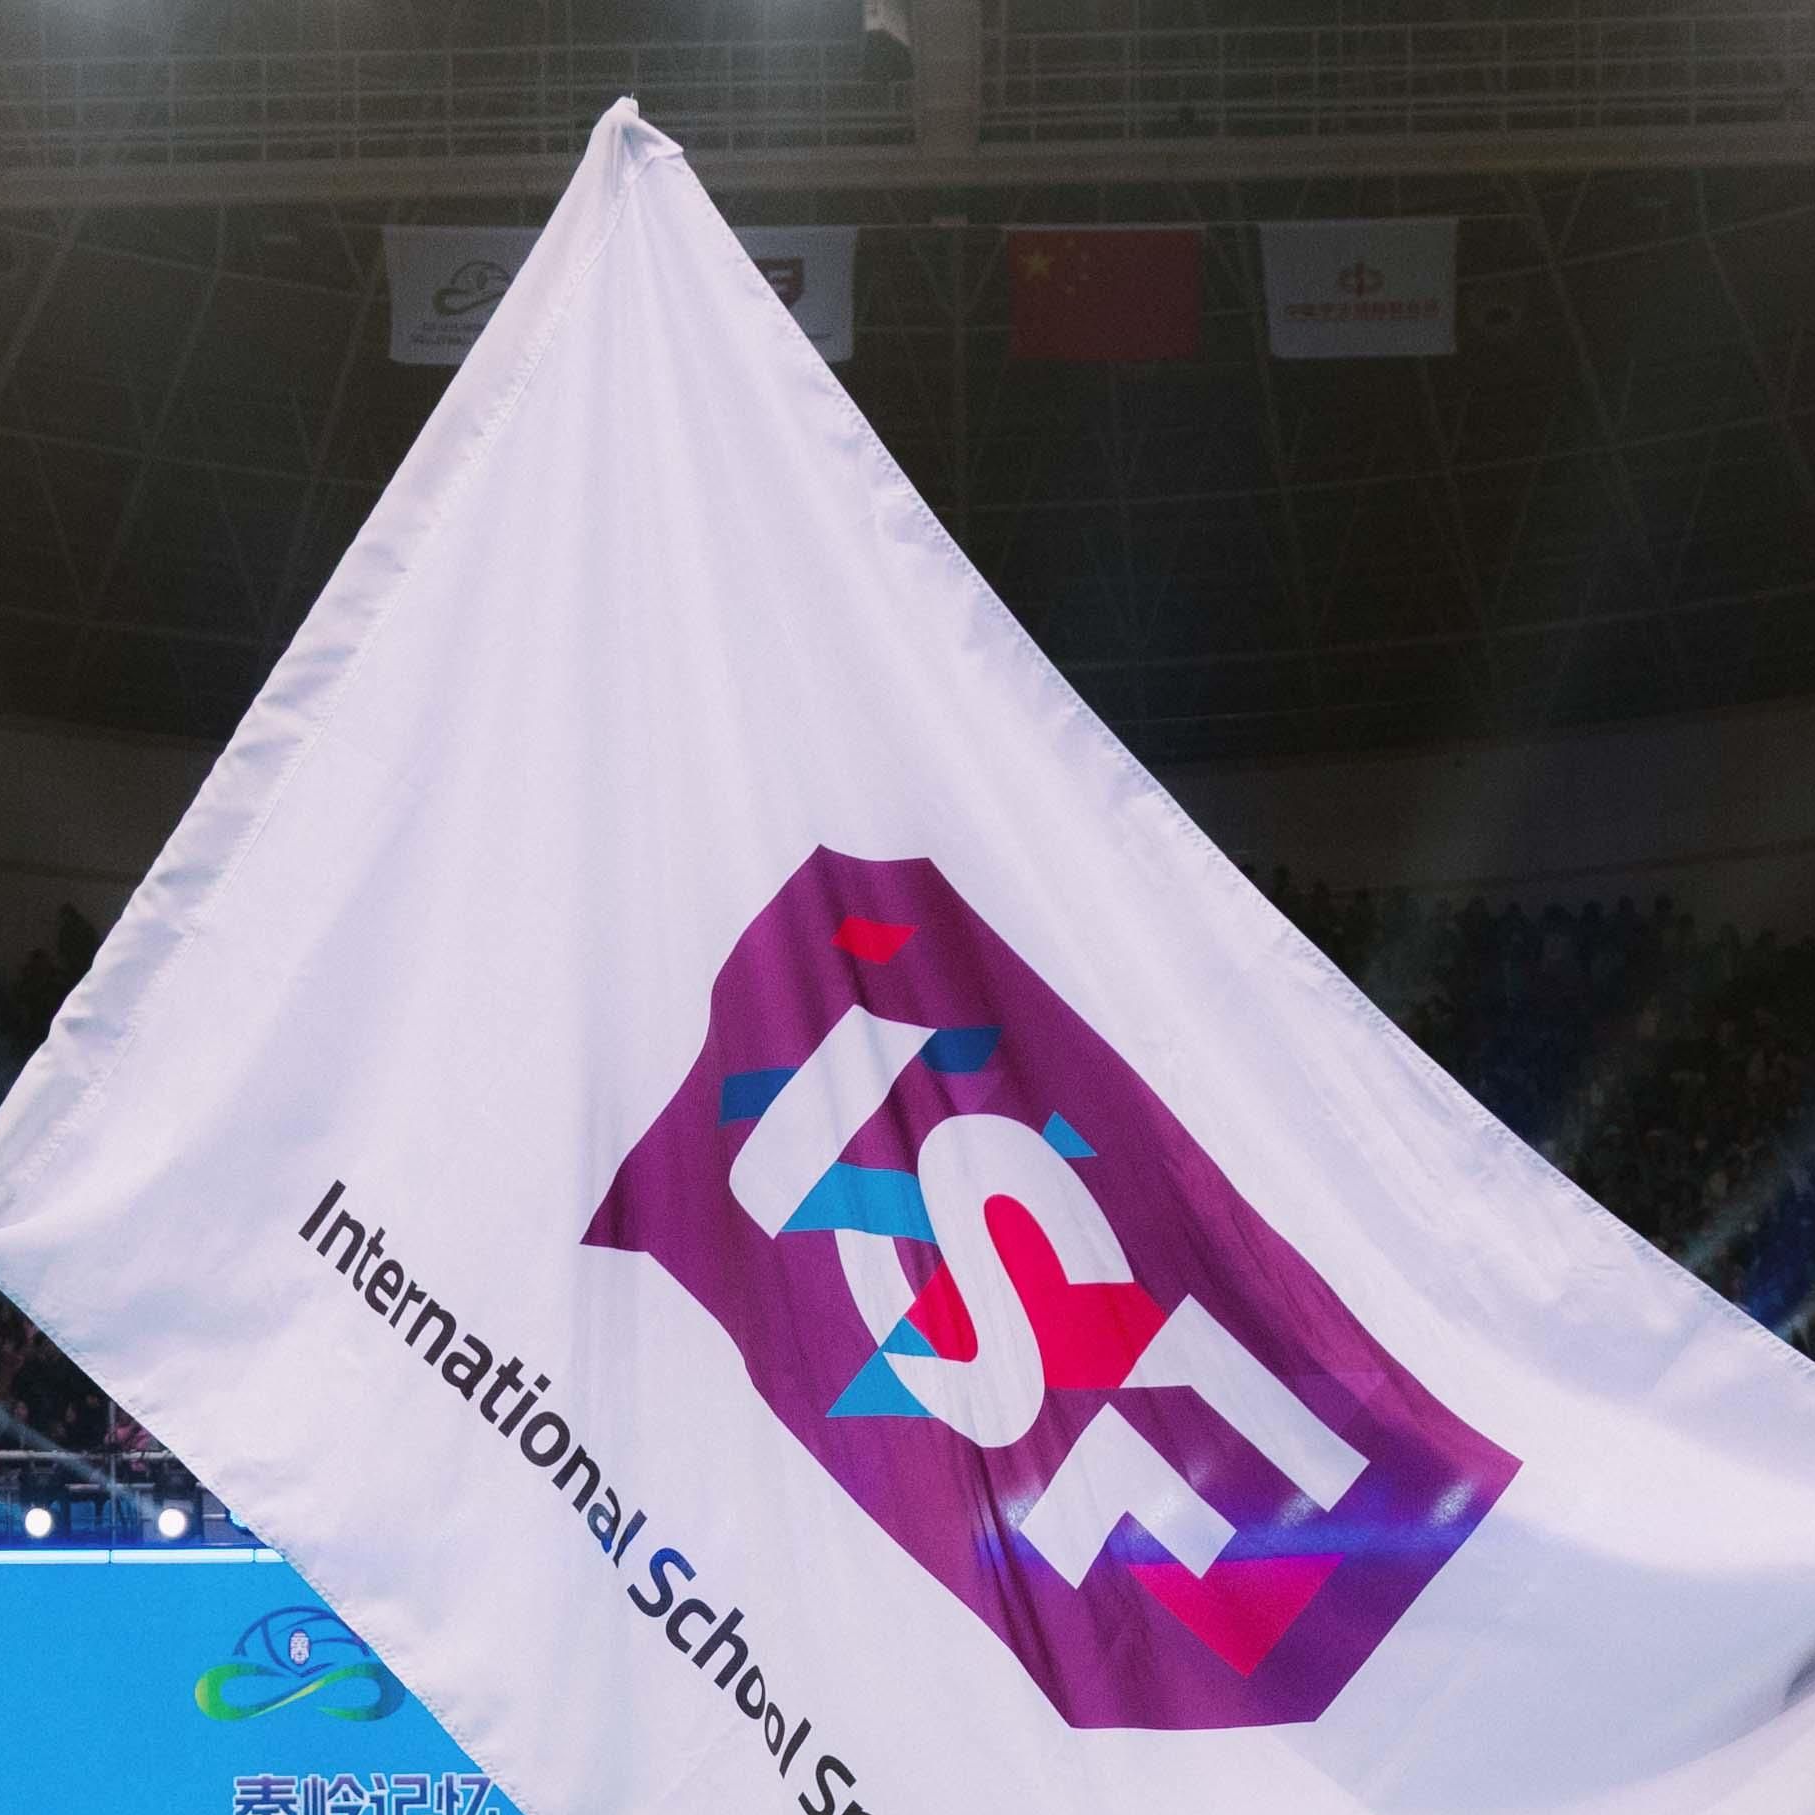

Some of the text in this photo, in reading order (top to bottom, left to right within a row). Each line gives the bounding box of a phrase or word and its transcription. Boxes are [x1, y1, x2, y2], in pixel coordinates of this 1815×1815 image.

[297, 1179, 648, 1568] International
[626, 1546, 813, 1779] School
[729, 1003, 1371, 1591] ISF
